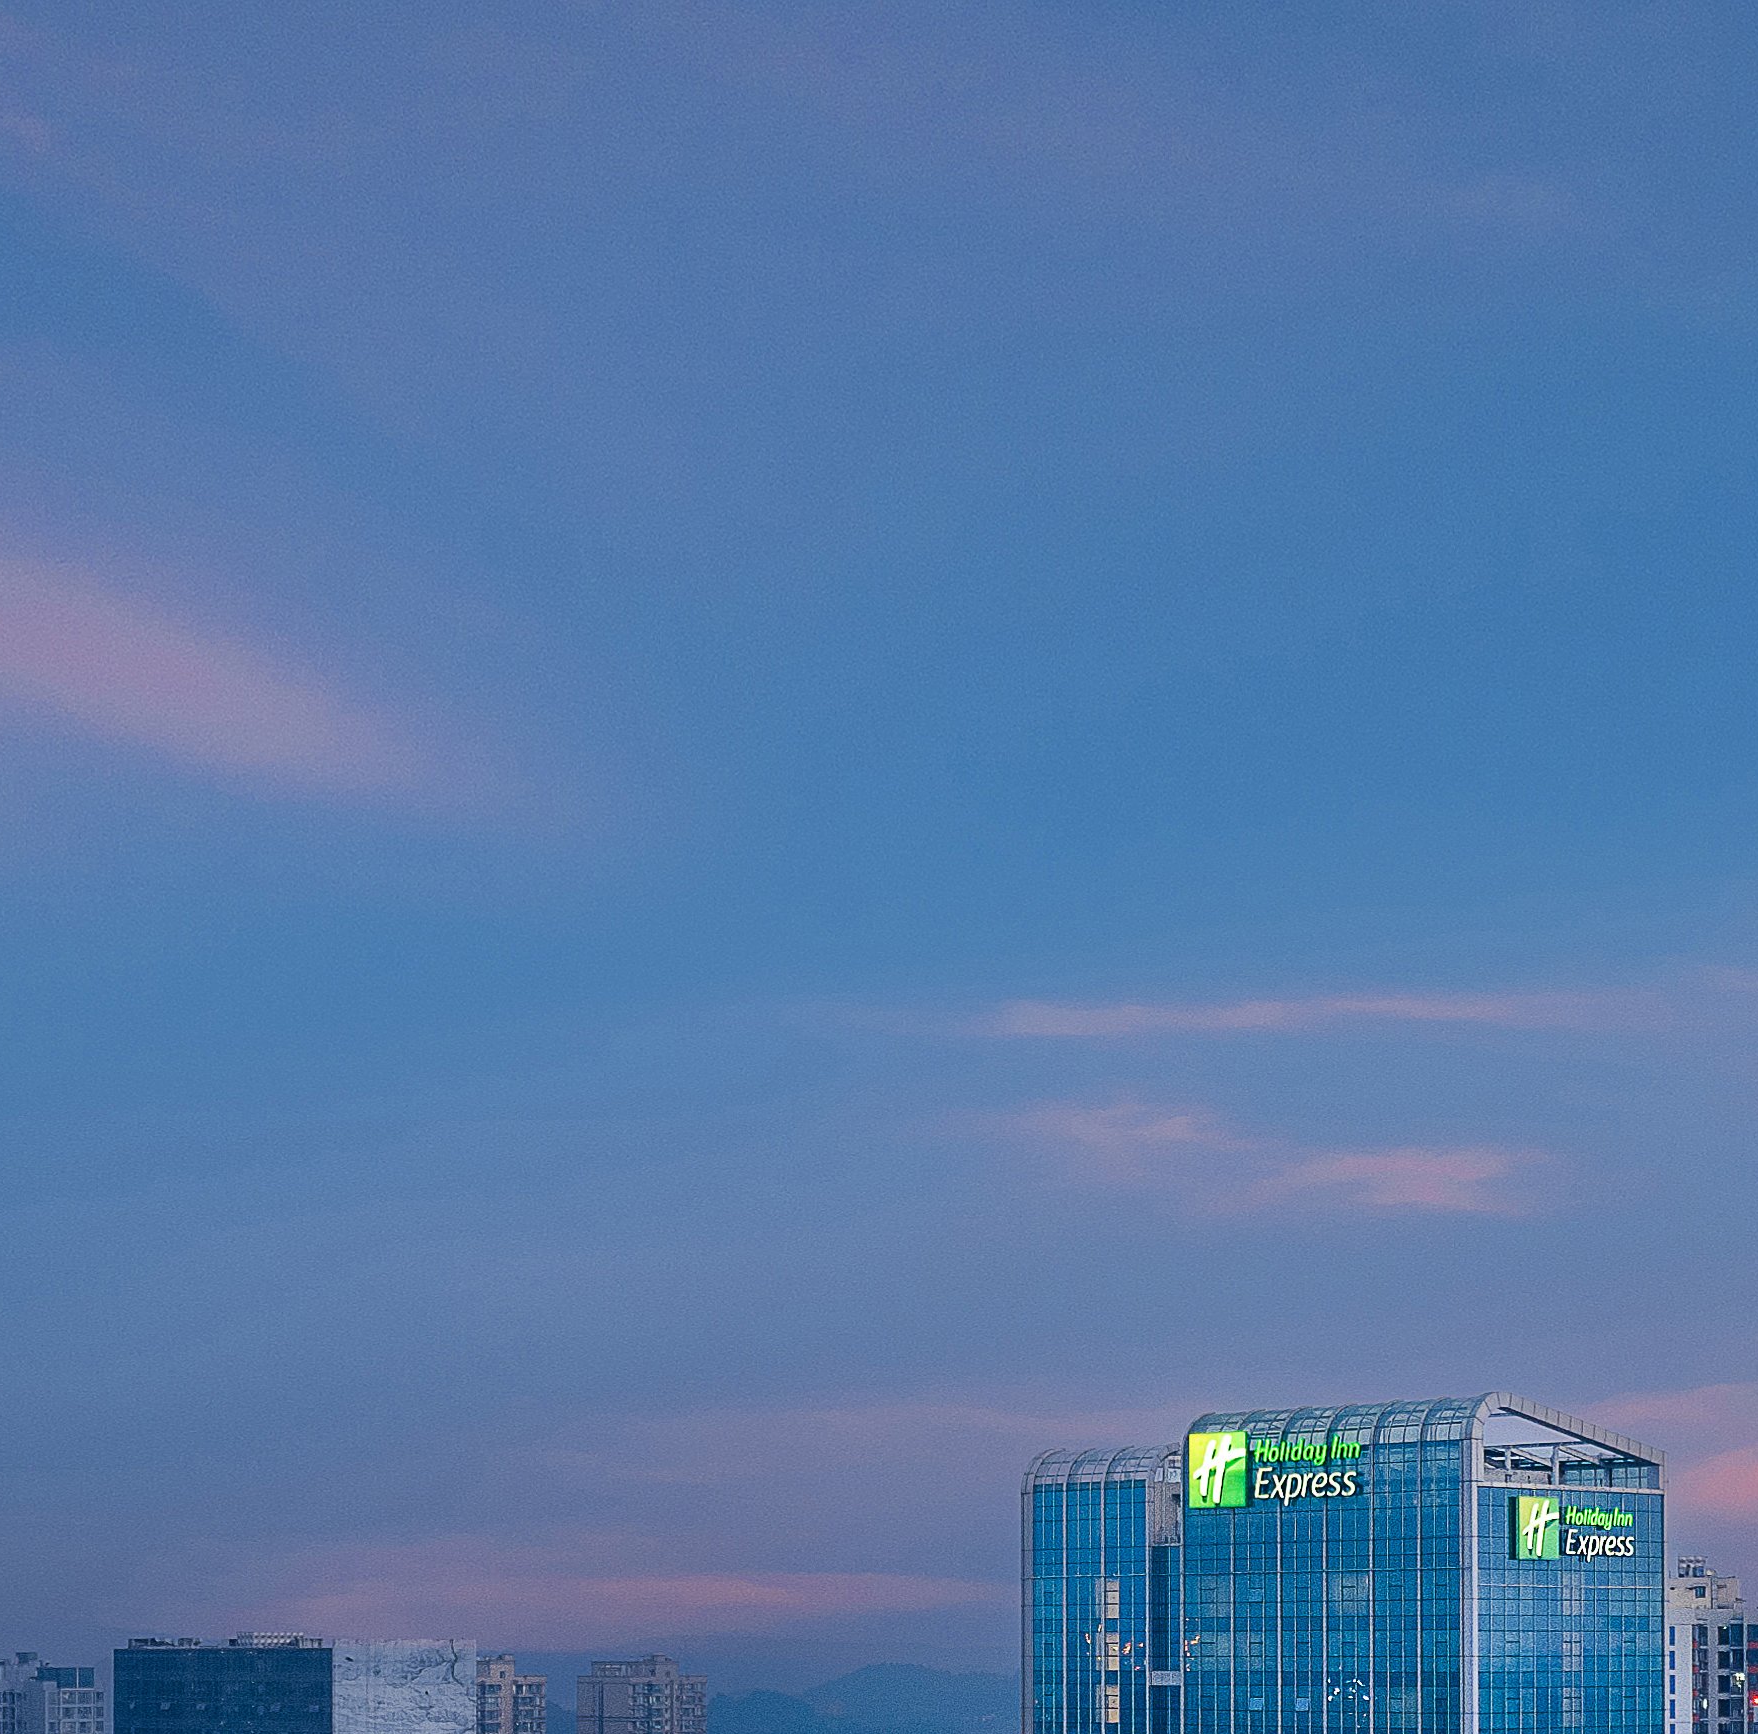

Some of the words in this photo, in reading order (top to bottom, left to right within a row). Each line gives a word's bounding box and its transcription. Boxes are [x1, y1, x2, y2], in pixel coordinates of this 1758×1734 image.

[1254, 1438, 1326, 1465] Holiday
[1330, 1435, 1361, 1459] Inn
[1253, 1468, 1357, 1506] Express
[1565, 1506, 1612, 1529] Holiday
[1612, 1510, 1633, 1528] Inn
[1565, 1528, 1634, 1562] Express
